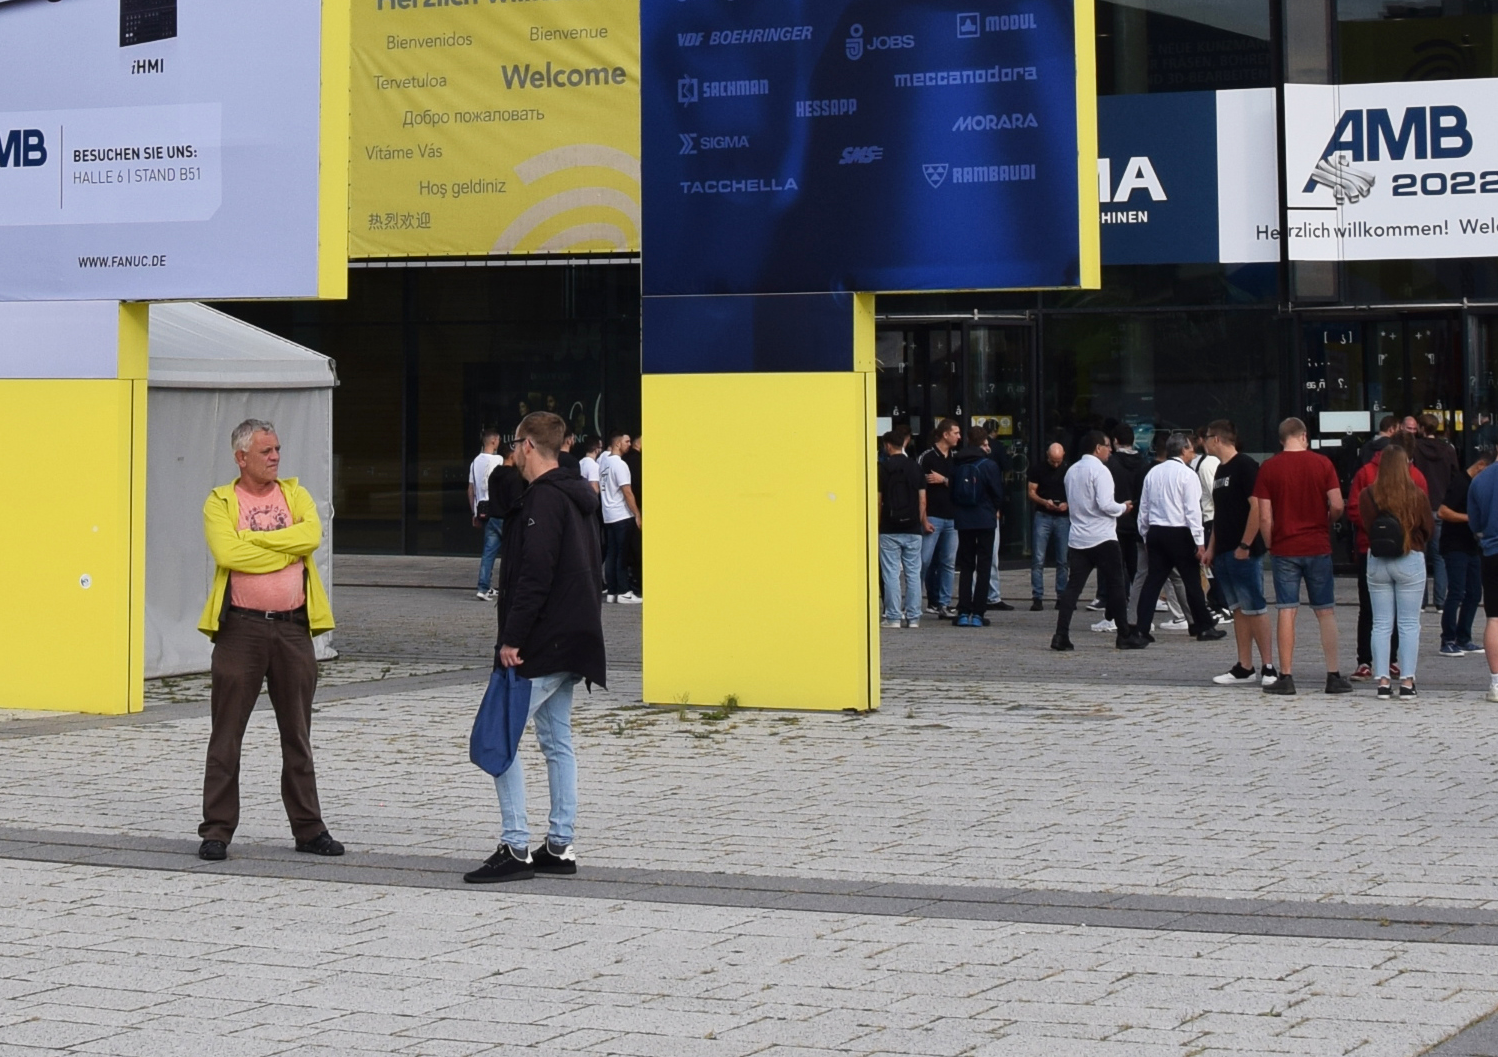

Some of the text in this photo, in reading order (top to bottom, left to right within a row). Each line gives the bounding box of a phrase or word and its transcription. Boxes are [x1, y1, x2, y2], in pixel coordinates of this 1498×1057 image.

[985, 13, 1037, 32] MODUL
[387, 26, 607, 50] Bienvenidos Bienvenue
[677, 25, 813, 47] VDF BOEHRINGER
[867, 35, 915, 51] JOBS
[131, 58, 165, 75] iHMI
[501, 61, 627, 89] Welcome
[374, 74, 447, 91] Tervetuloa
[703, 79, 769, 98] SACHMAN
[796, 98, 857, 118] HESSAPP
[403, 107, 545, 129] Добро пожаловать
[952, 113, 1037, 132] MORARA
[365, 143, 443, 160] Vítáme Vás
[701, 135, 749, 150] SIGMA
[1301, 105, 1473, 195] AMB
[73, 145, 199, 163] BESUCHEN SIE UNS:
[73, 167, 202, 185] HALLE 6 STAND B51
[953, 164, 1036, 184] RAMBAUDI
[419, 179, 506, 198] Hoş geldiniz
[681, 178, 798, 195] TACCHELLA
[368, 212, 431, 230] 热烈欢迎
[1256, 221, 1330, 241] Herzlich
[1333, 218, 1449, 239] willkommen!
[78, 253, 167, 269] WWW.FANUC.DE
